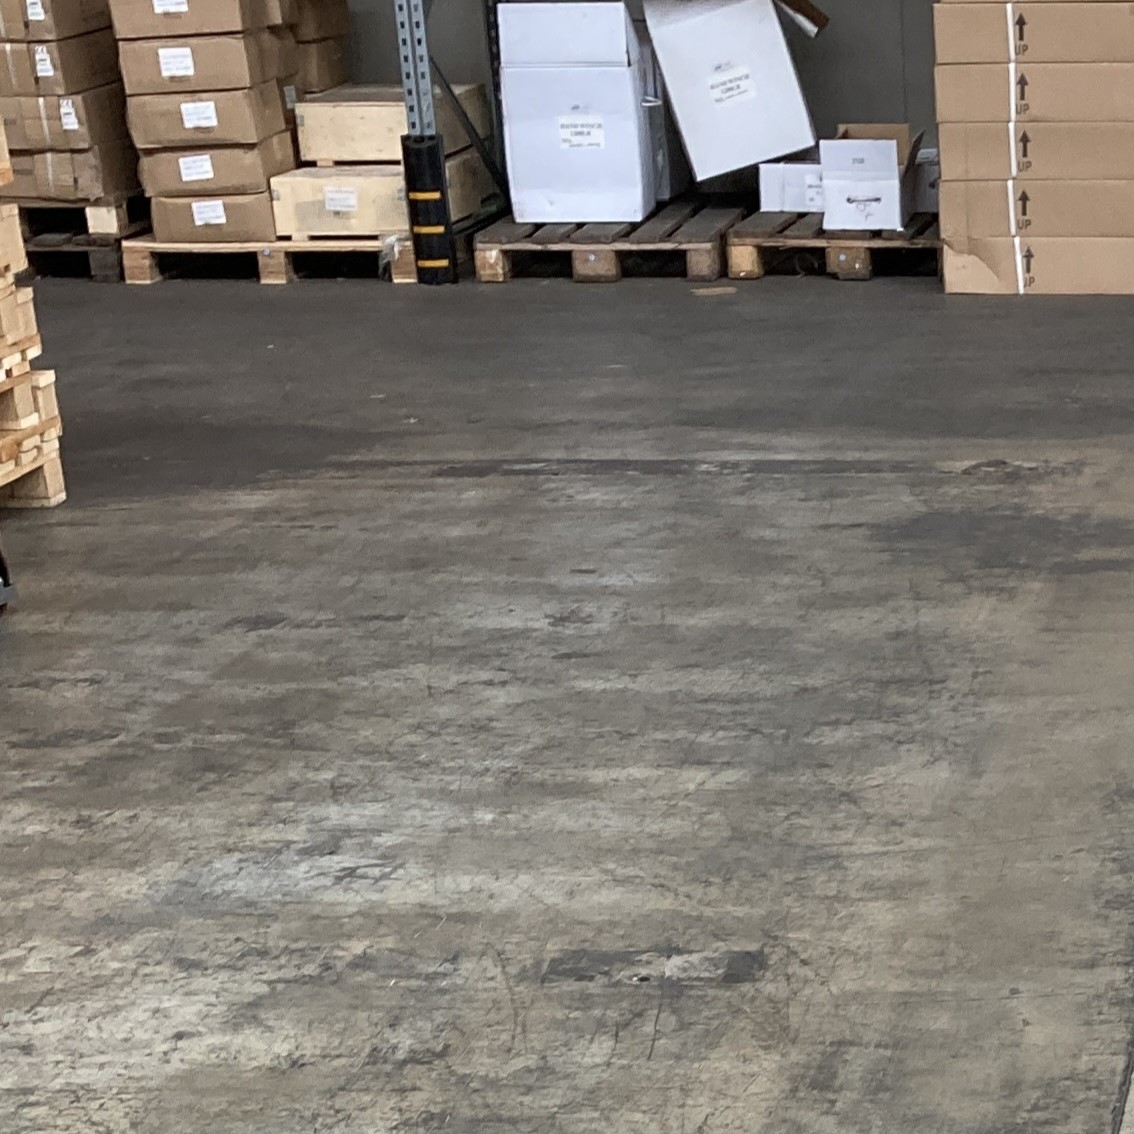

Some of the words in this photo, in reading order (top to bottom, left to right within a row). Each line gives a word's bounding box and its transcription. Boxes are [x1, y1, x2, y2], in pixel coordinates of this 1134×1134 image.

[1014, 43, 1029, 56] UP
[1015, 103, 1030, 115] UP
[1017, 161, 1032, 172] UP
[1017, 219, 1032, 230] UP
